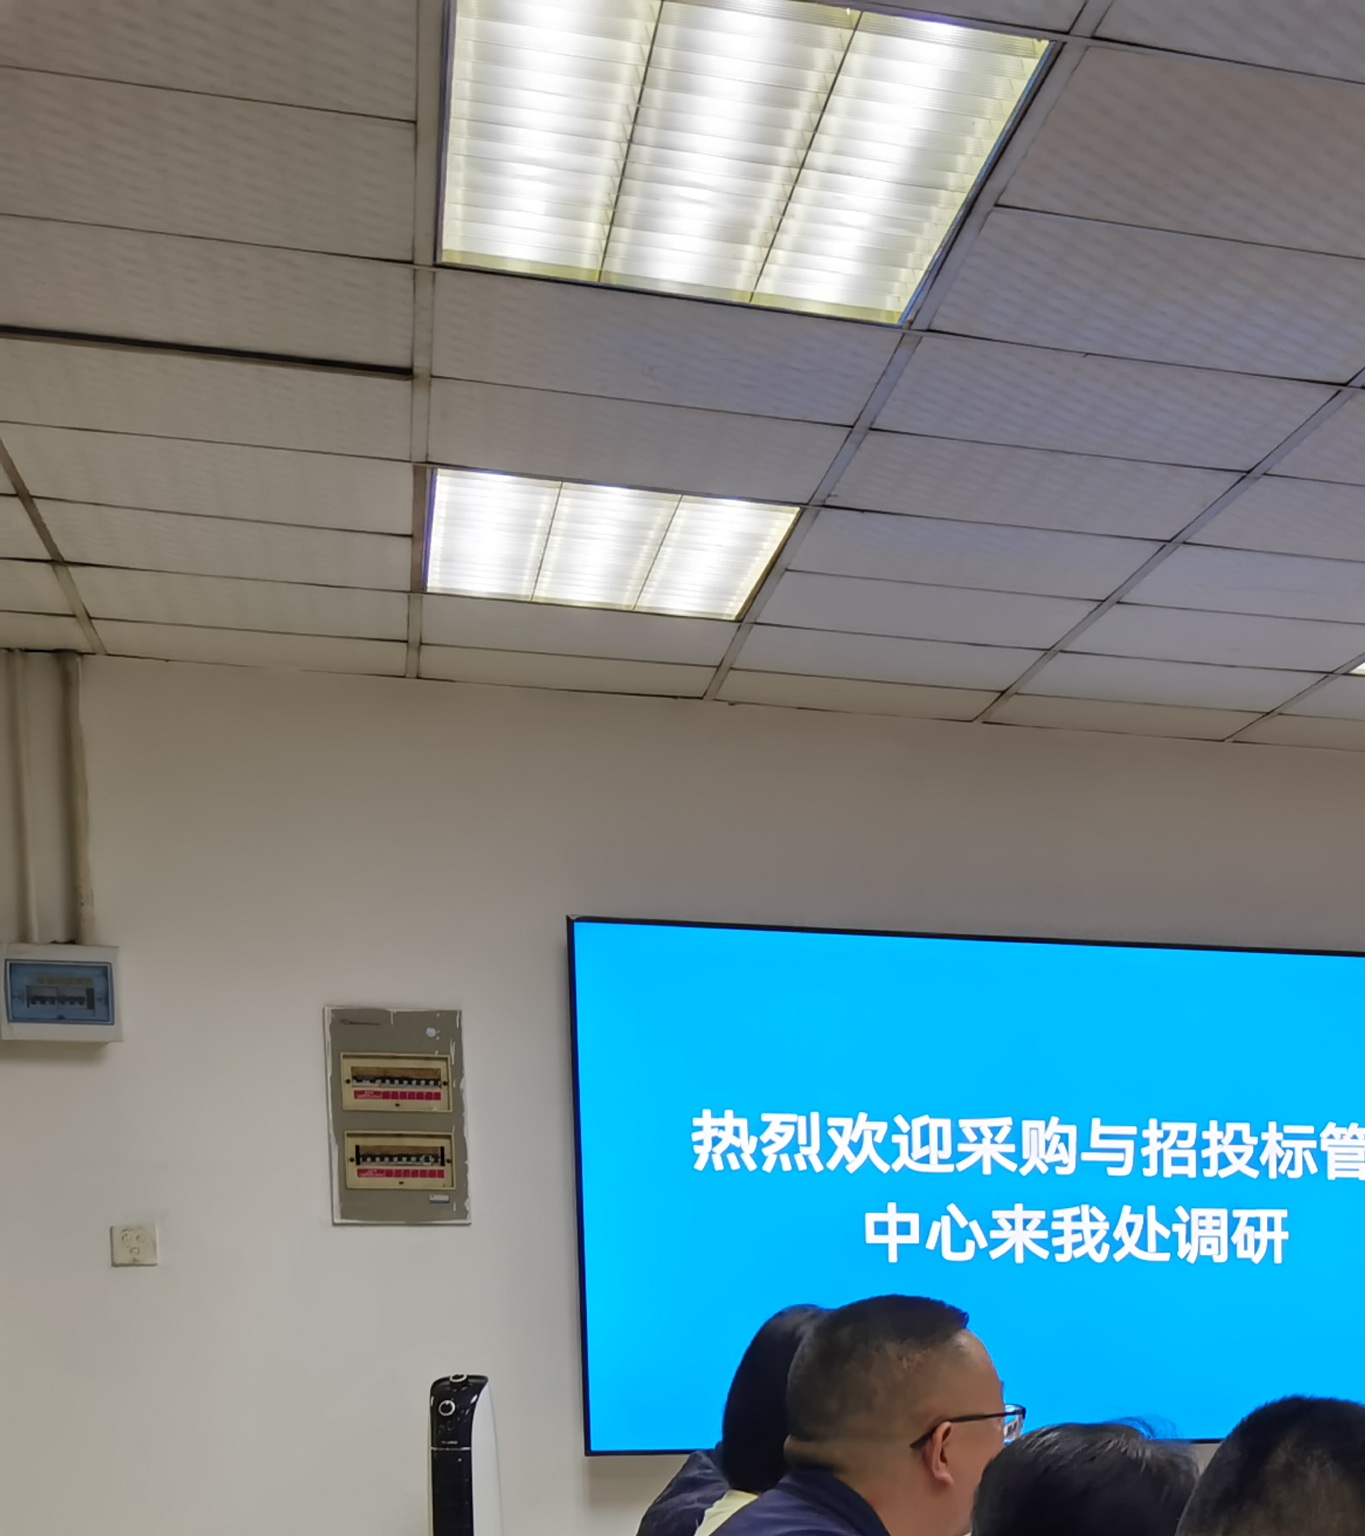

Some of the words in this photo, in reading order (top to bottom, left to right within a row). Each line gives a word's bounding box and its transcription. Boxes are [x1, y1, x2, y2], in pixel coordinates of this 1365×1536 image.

[862, 1201, 1291, 1265] 中心来我处调研
